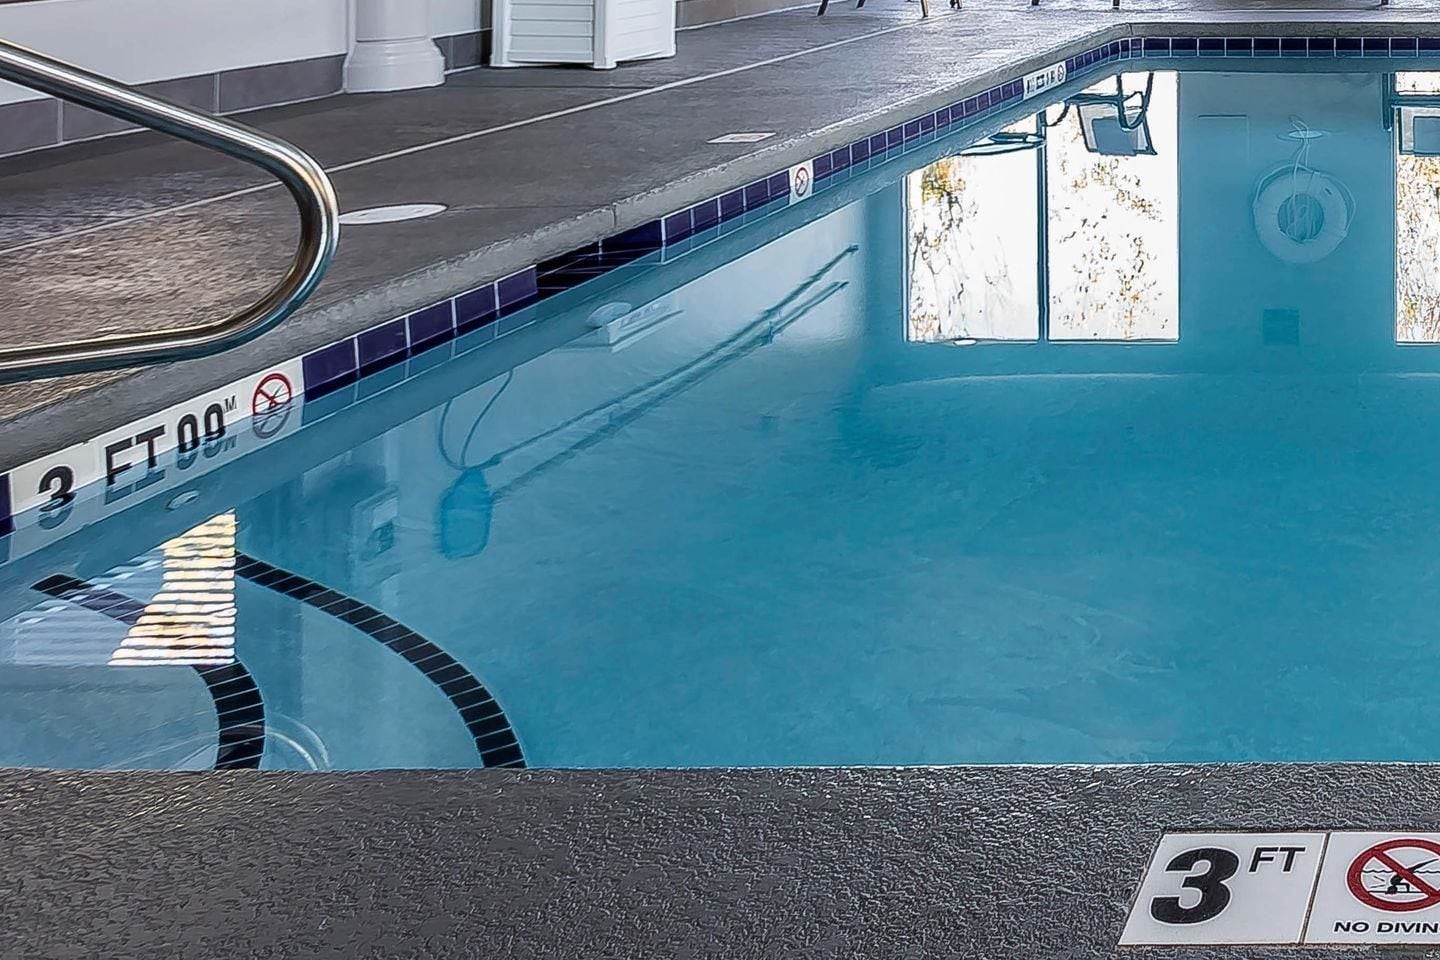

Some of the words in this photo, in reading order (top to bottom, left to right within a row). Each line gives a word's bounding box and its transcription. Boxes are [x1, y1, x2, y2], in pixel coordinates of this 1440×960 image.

[105, 424, 166, 486] FT
[1150, 846, 1240, 925] 3
[1249, 846, 1307, 873] FT
[1333, 921, 1370, 934] NO
